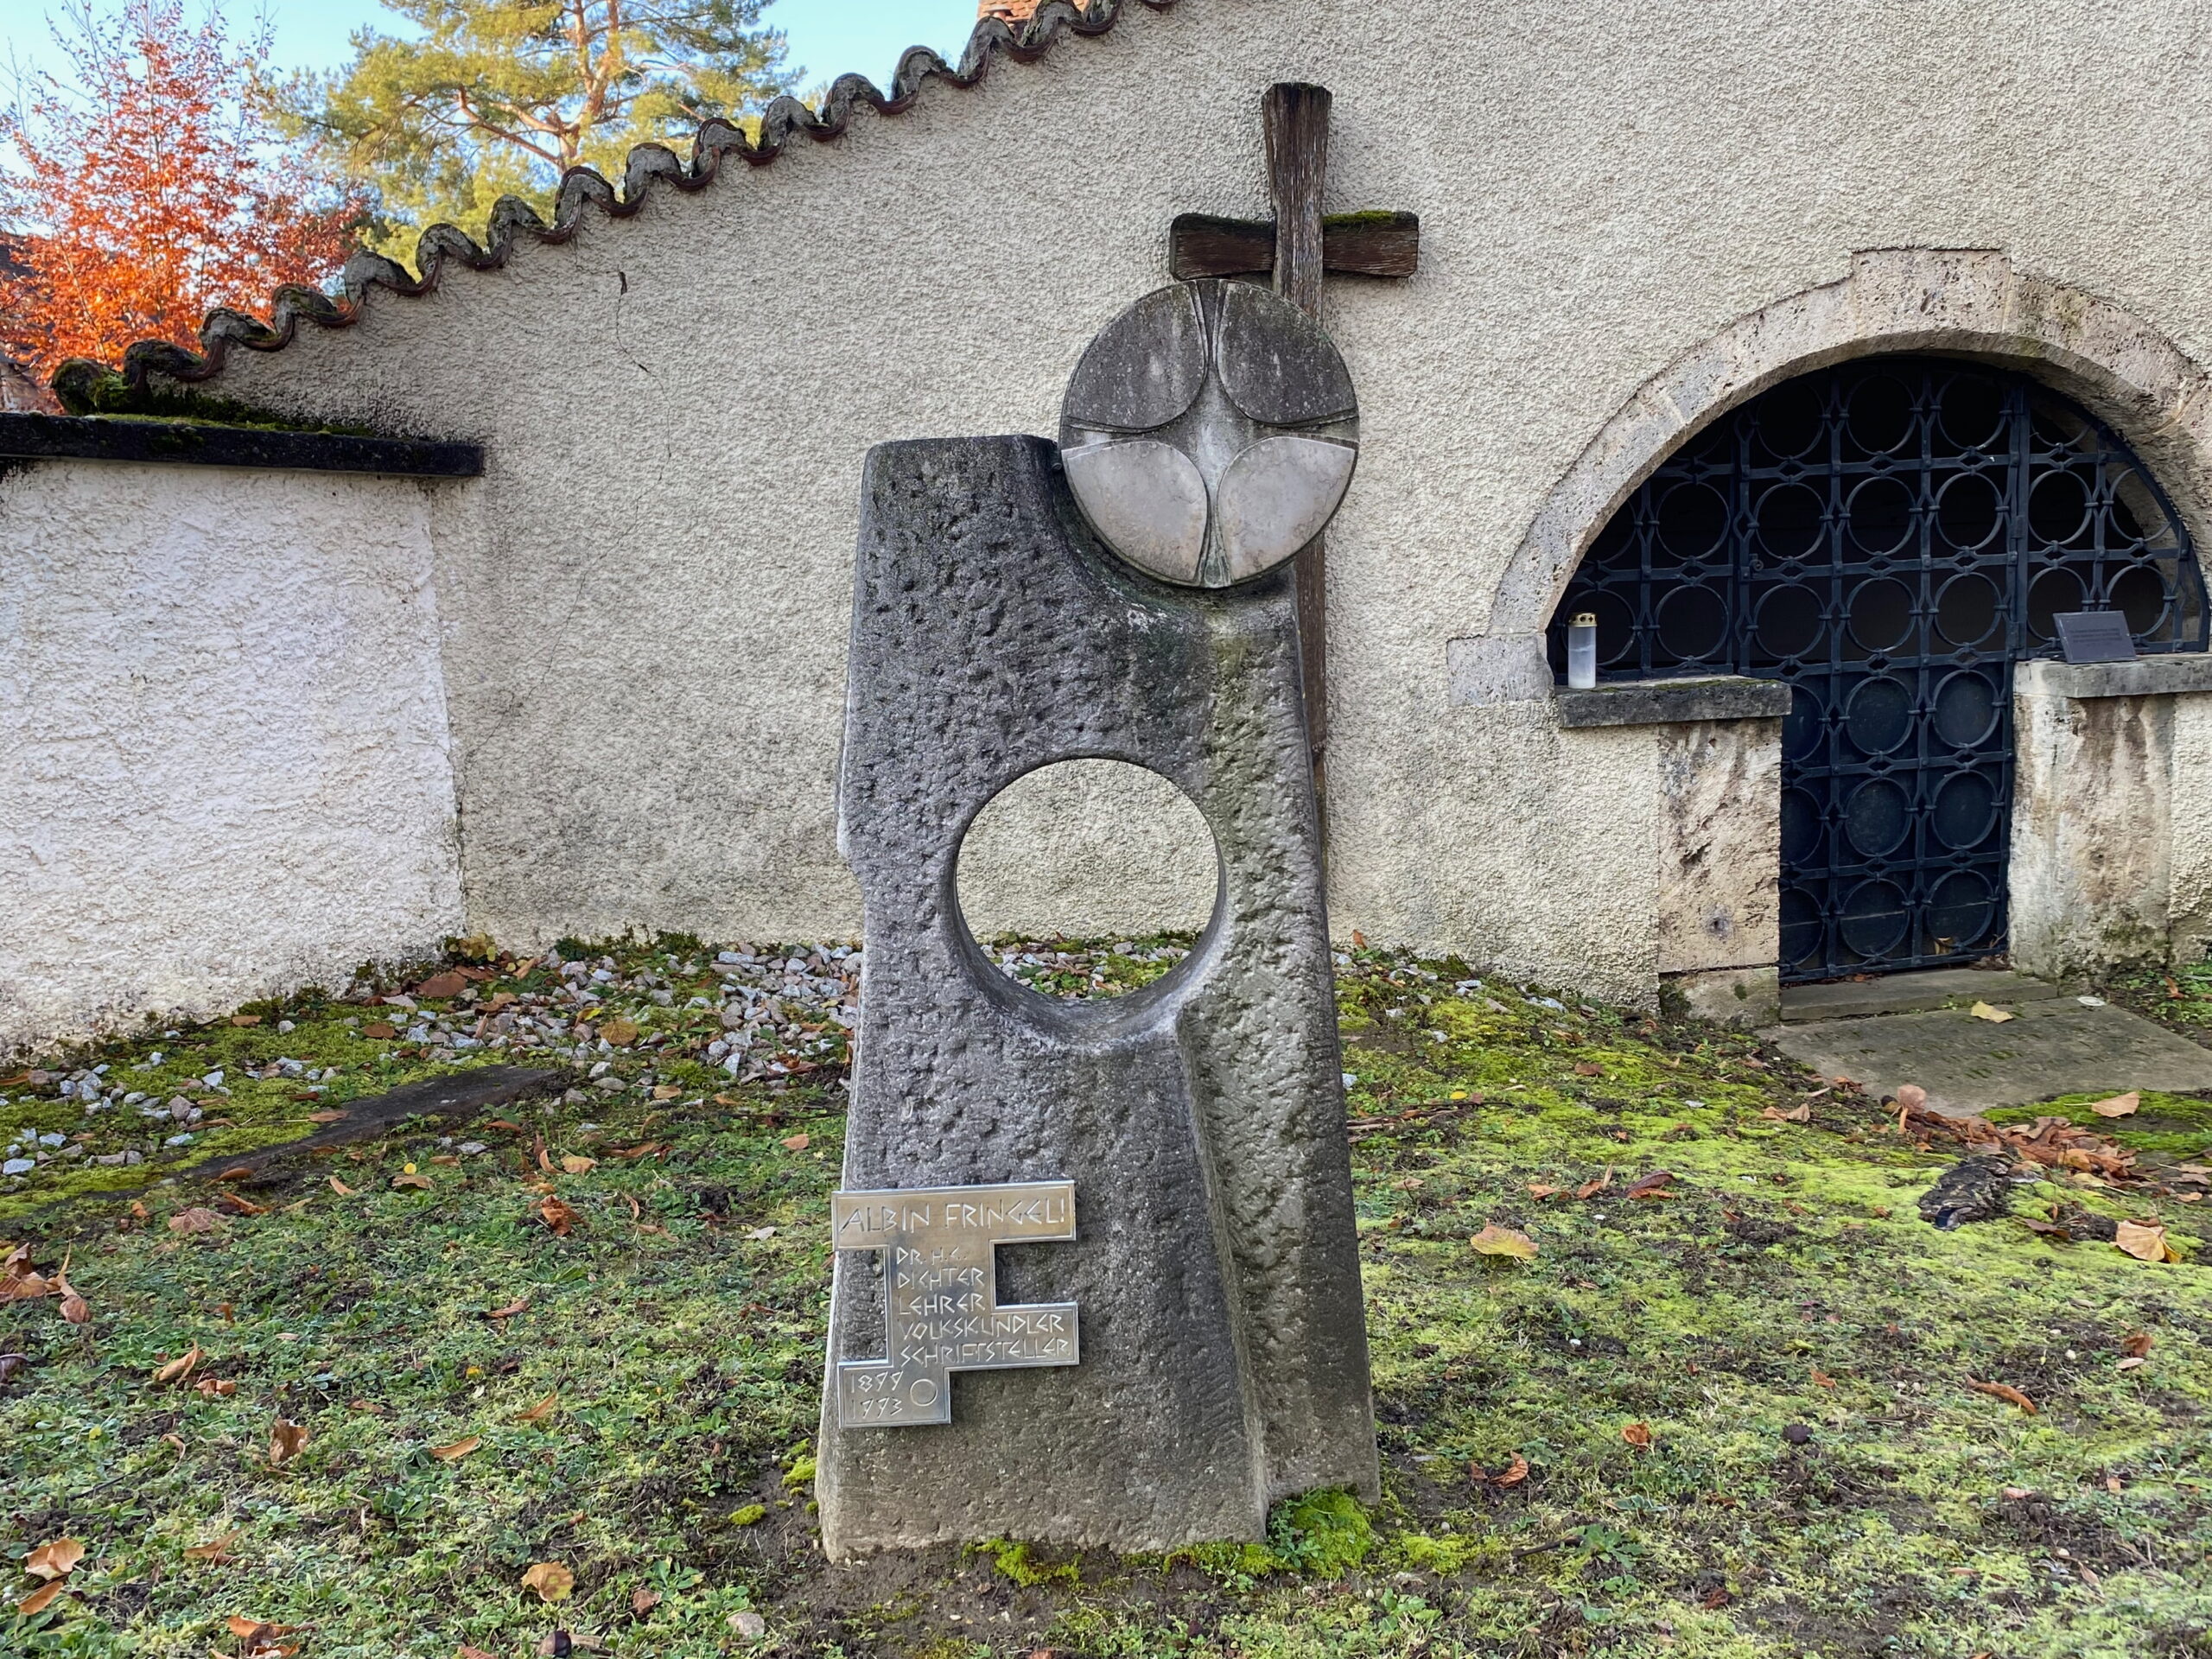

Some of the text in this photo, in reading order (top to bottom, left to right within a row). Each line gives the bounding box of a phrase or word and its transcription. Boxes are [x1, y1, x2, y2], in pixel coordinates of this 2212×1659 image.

[839, 1198, 1065, 1234] ALBIN FRINGELI
[897, 1266, 985, 1291] DICHTER
[898, 1292, 986, 1316] LEHRER
[897, 1313, 1065, 1341] VOLKSKUNDLER
[899, 1337, 1071, 1368] SCHRIFTSTELLER
[851, 1370, 904, 1393] 1899
[851, 1396, 903, 1420] 1993
